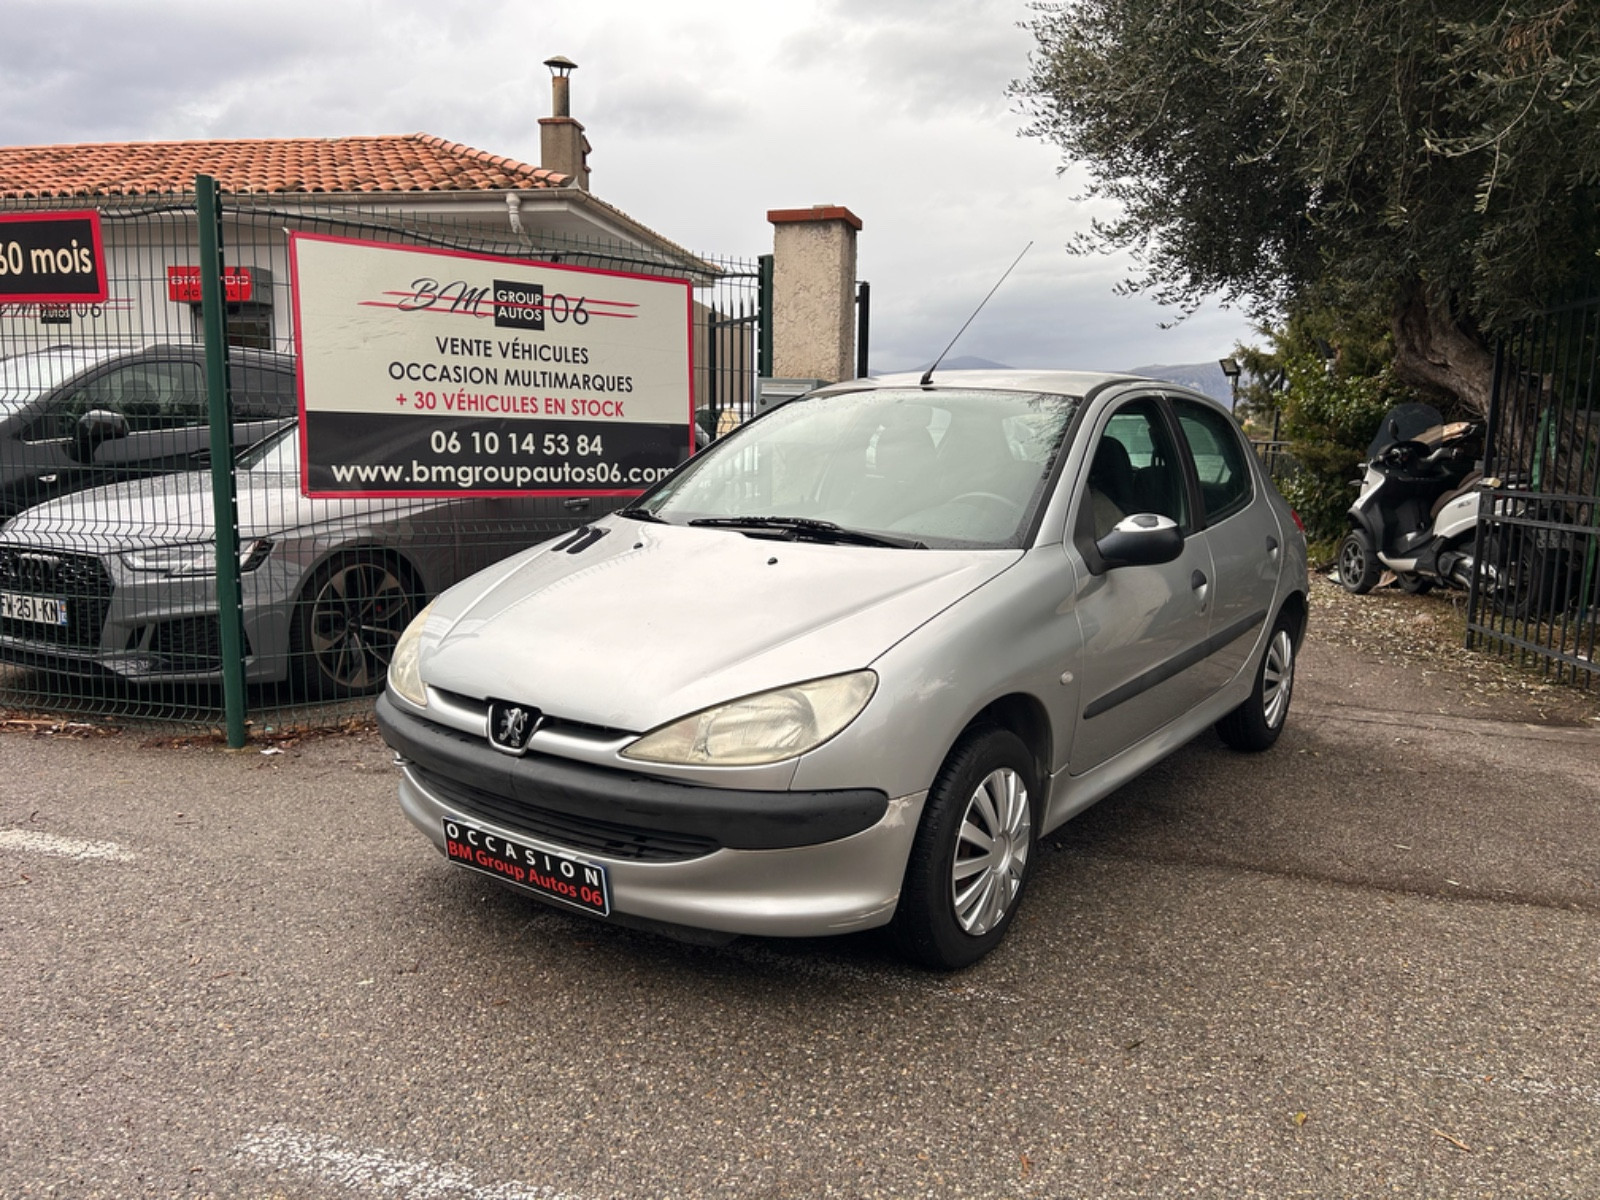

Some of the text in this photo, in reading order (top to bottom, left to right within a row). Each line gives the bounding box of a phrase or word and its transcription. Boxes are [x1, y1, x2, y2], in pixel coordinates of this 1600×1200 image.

[30, 239, 92, 274] mois
[398, 278, 490, 319] BM
[496, 290, 542, 304] GROUP
[551, 293, 589, 325] 06
[498, 307, 542, 322] AUTOS
[435, 336, 589, 365] VENTE VÉHICULES
[388, 361, 633, 393] OCCASION MULTIMARQUES
[414, 391, 437, 410] 30
[442, 388, 539, 414] VÉHICULES
[544, 398, 566, 415] EN
[571, 398, 624, 417] STOCK
[431, 431, 603, 457] 06 10 14 53 84
[447, 823, 598, 886] OCCASION
[448, 841, 603, 906] BM Group Autos 06
